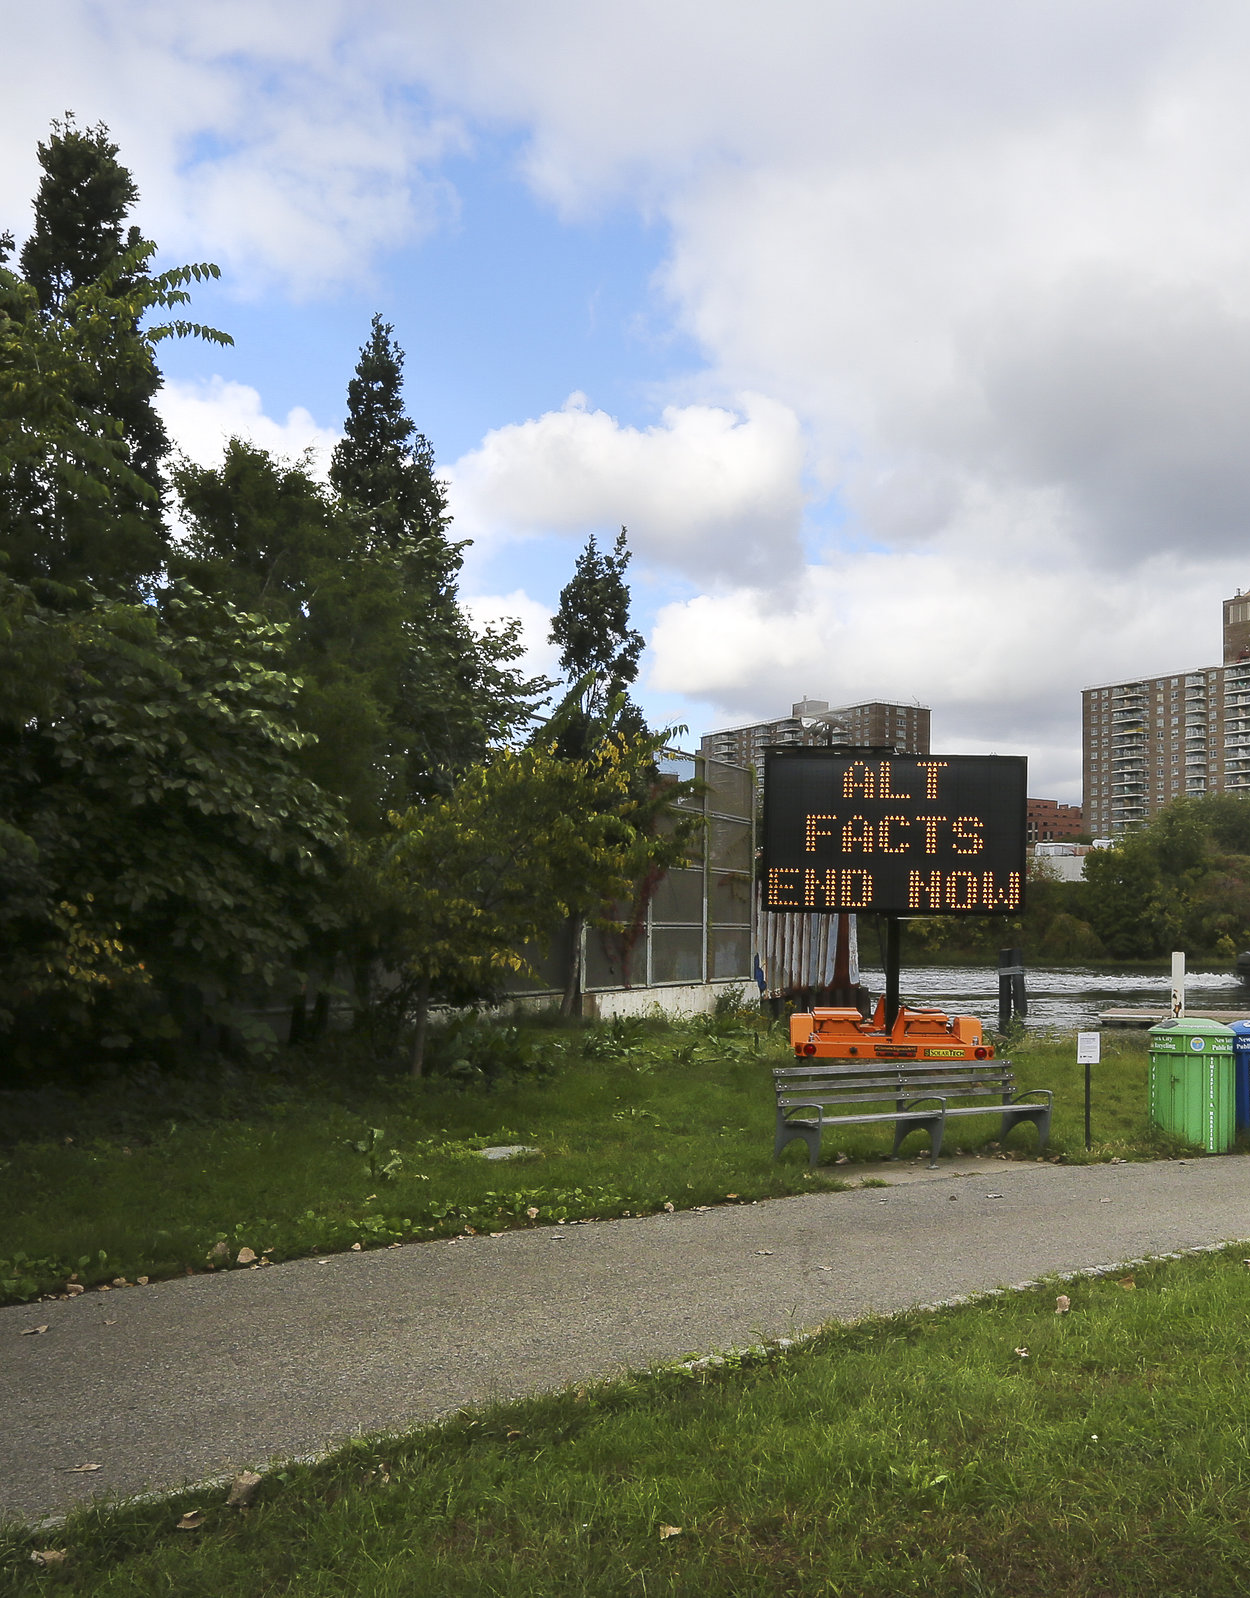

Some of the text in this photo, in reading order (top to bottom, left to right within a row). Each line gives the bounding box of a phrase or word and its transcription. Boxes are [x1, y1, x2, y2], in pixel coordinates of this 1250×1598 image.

[843, 760, 949, 799] ALT
[805, 813, 984, 854] FACTS
[768, 867, 1020, 910] END NOW
